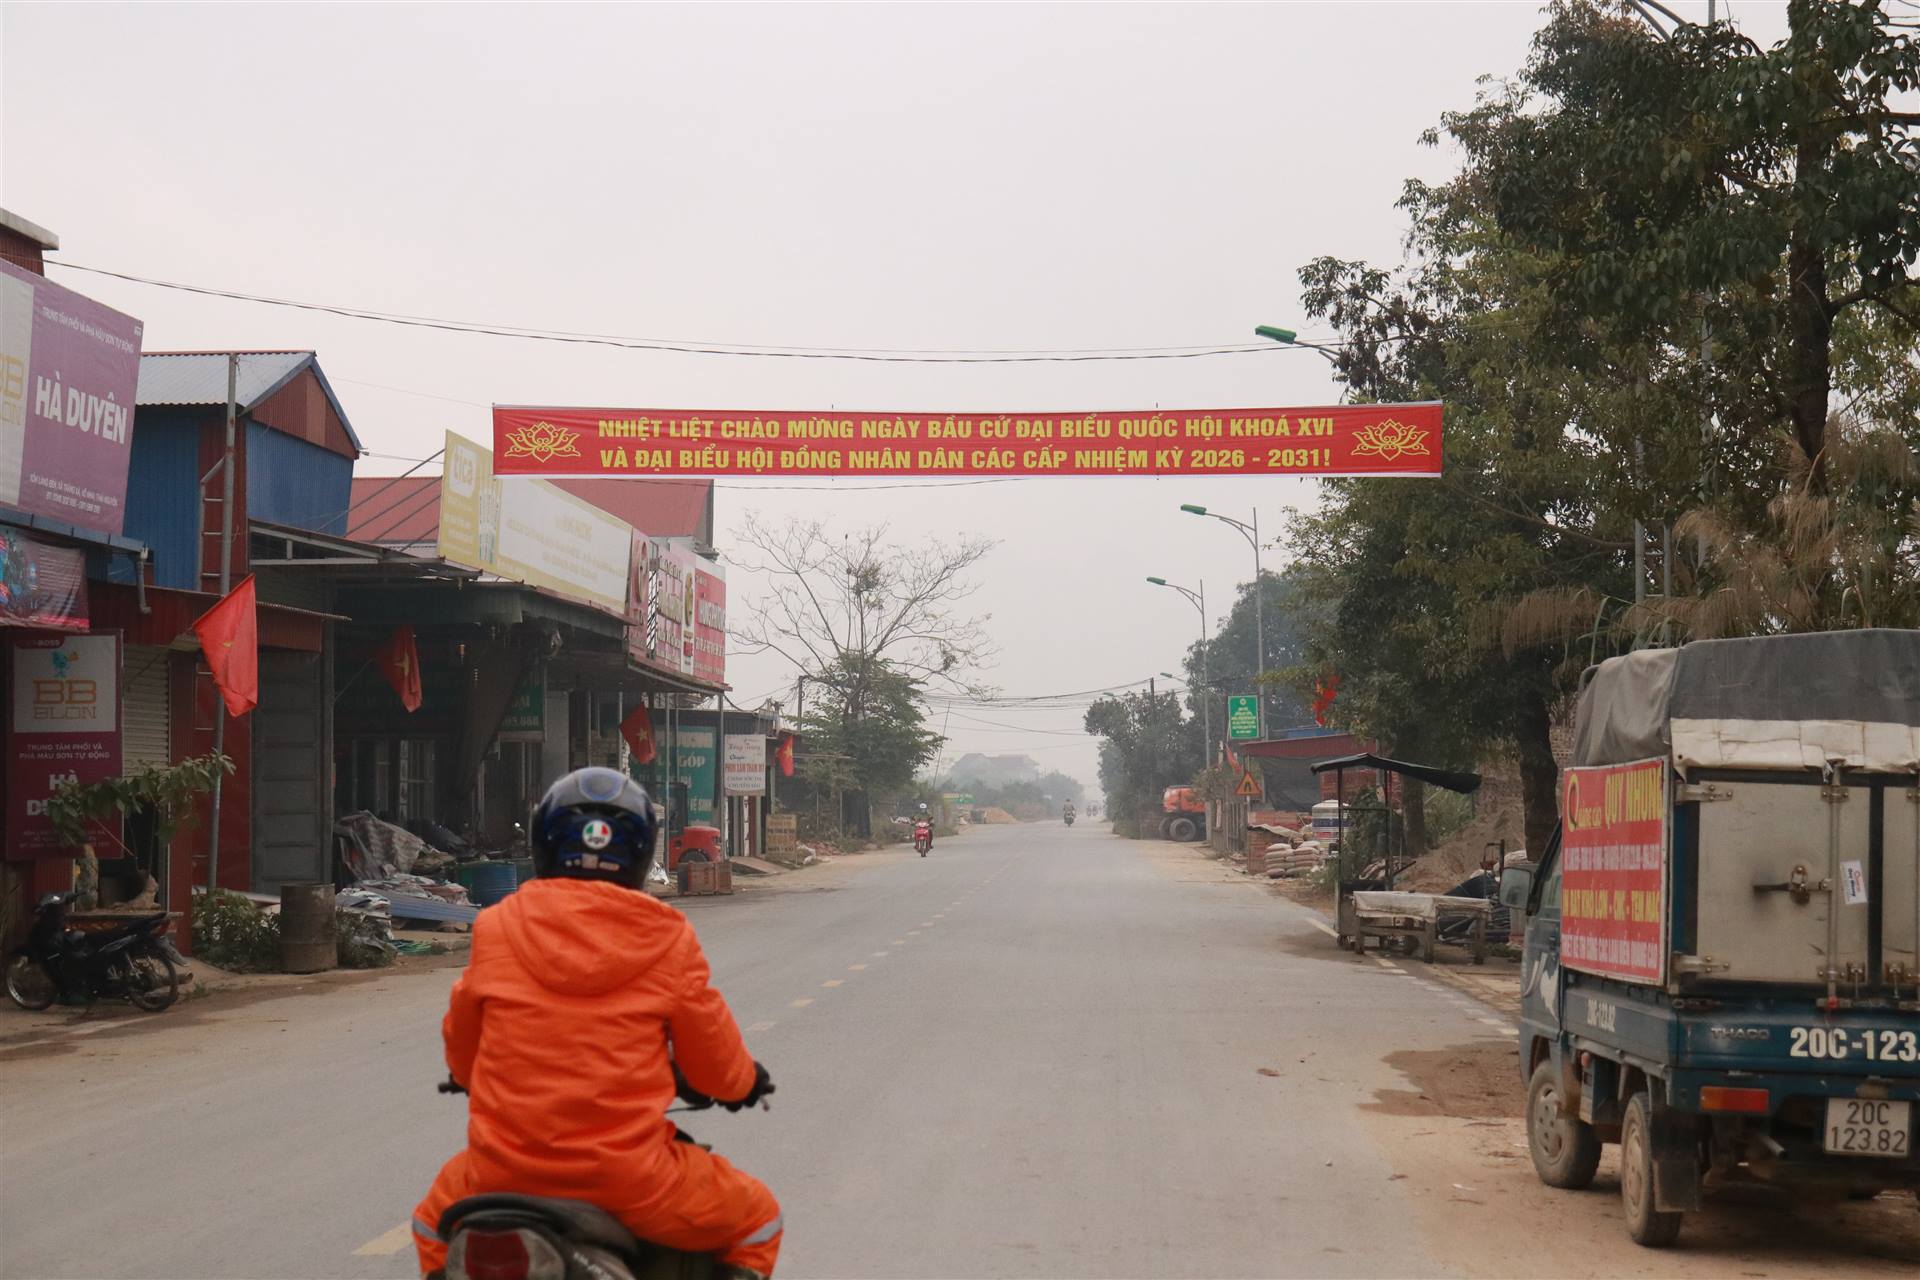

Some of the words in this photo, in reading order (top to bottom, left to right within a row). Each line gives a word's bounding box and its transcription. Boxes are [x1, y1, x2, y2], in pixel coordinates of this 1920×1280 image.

[35, 370, 62, 423] HÀ
[66, 386, 128, 445] DUYÊN
[599, 416, 662, 441] NHIỆT
[669, 416, 713, 441] LIỆT
[721, 416, 780, 438] CHÀO
[788, 416, 853, 439] MỪNG
[861, 416, 920, 439] NGÀY
[928, 415, 972, 439] BẦU
[979, 415, 1010, 438] CỬ
[1016, 419, 1052, 441] ĐẠI
[1061, 414, 1111, 438] BIỂU
[1119, 413, 1179, 439] QUỐC
[1186, 415, 1223, 440] HỘI
[1230, 414, 1290, 437] KHOÁ
[1297, 417, 1334, 436] XVI
[600, 446, 629, 468] VÀ
[635, 449, 672, 471] ĐẠI
[680, 443, 729, 468] BIỂU
[737, 447, 774, 472] HỘI
[780, 445, 842, 469] ĐỒNG
[849, 447, 911, 469] NHÂN
[918, 447, 964, 469] DÂN
[972, 447, 1016, 469] CÁC
[1023, 444, 1068, 468] CẤP
[1075, 446, 1148, 472] NHIỆM
[1156, 446, 1184, 468] KỲ
[1191, 449, 1245, 468] 2026
[1268, 448, 1331, 467] 2031!
[33, 679, 97, 705] BB
[27, 743, 53, 752] TRUNG
[55, 742, 71, 751] TÂM
[93, 741, 103, 751] VÀ
[1711, 1027, 1770, 1041] THACO
[1846, 1101, 1890, 1126] 20C
[1831, 1126, 1907, 1153] 123.82
